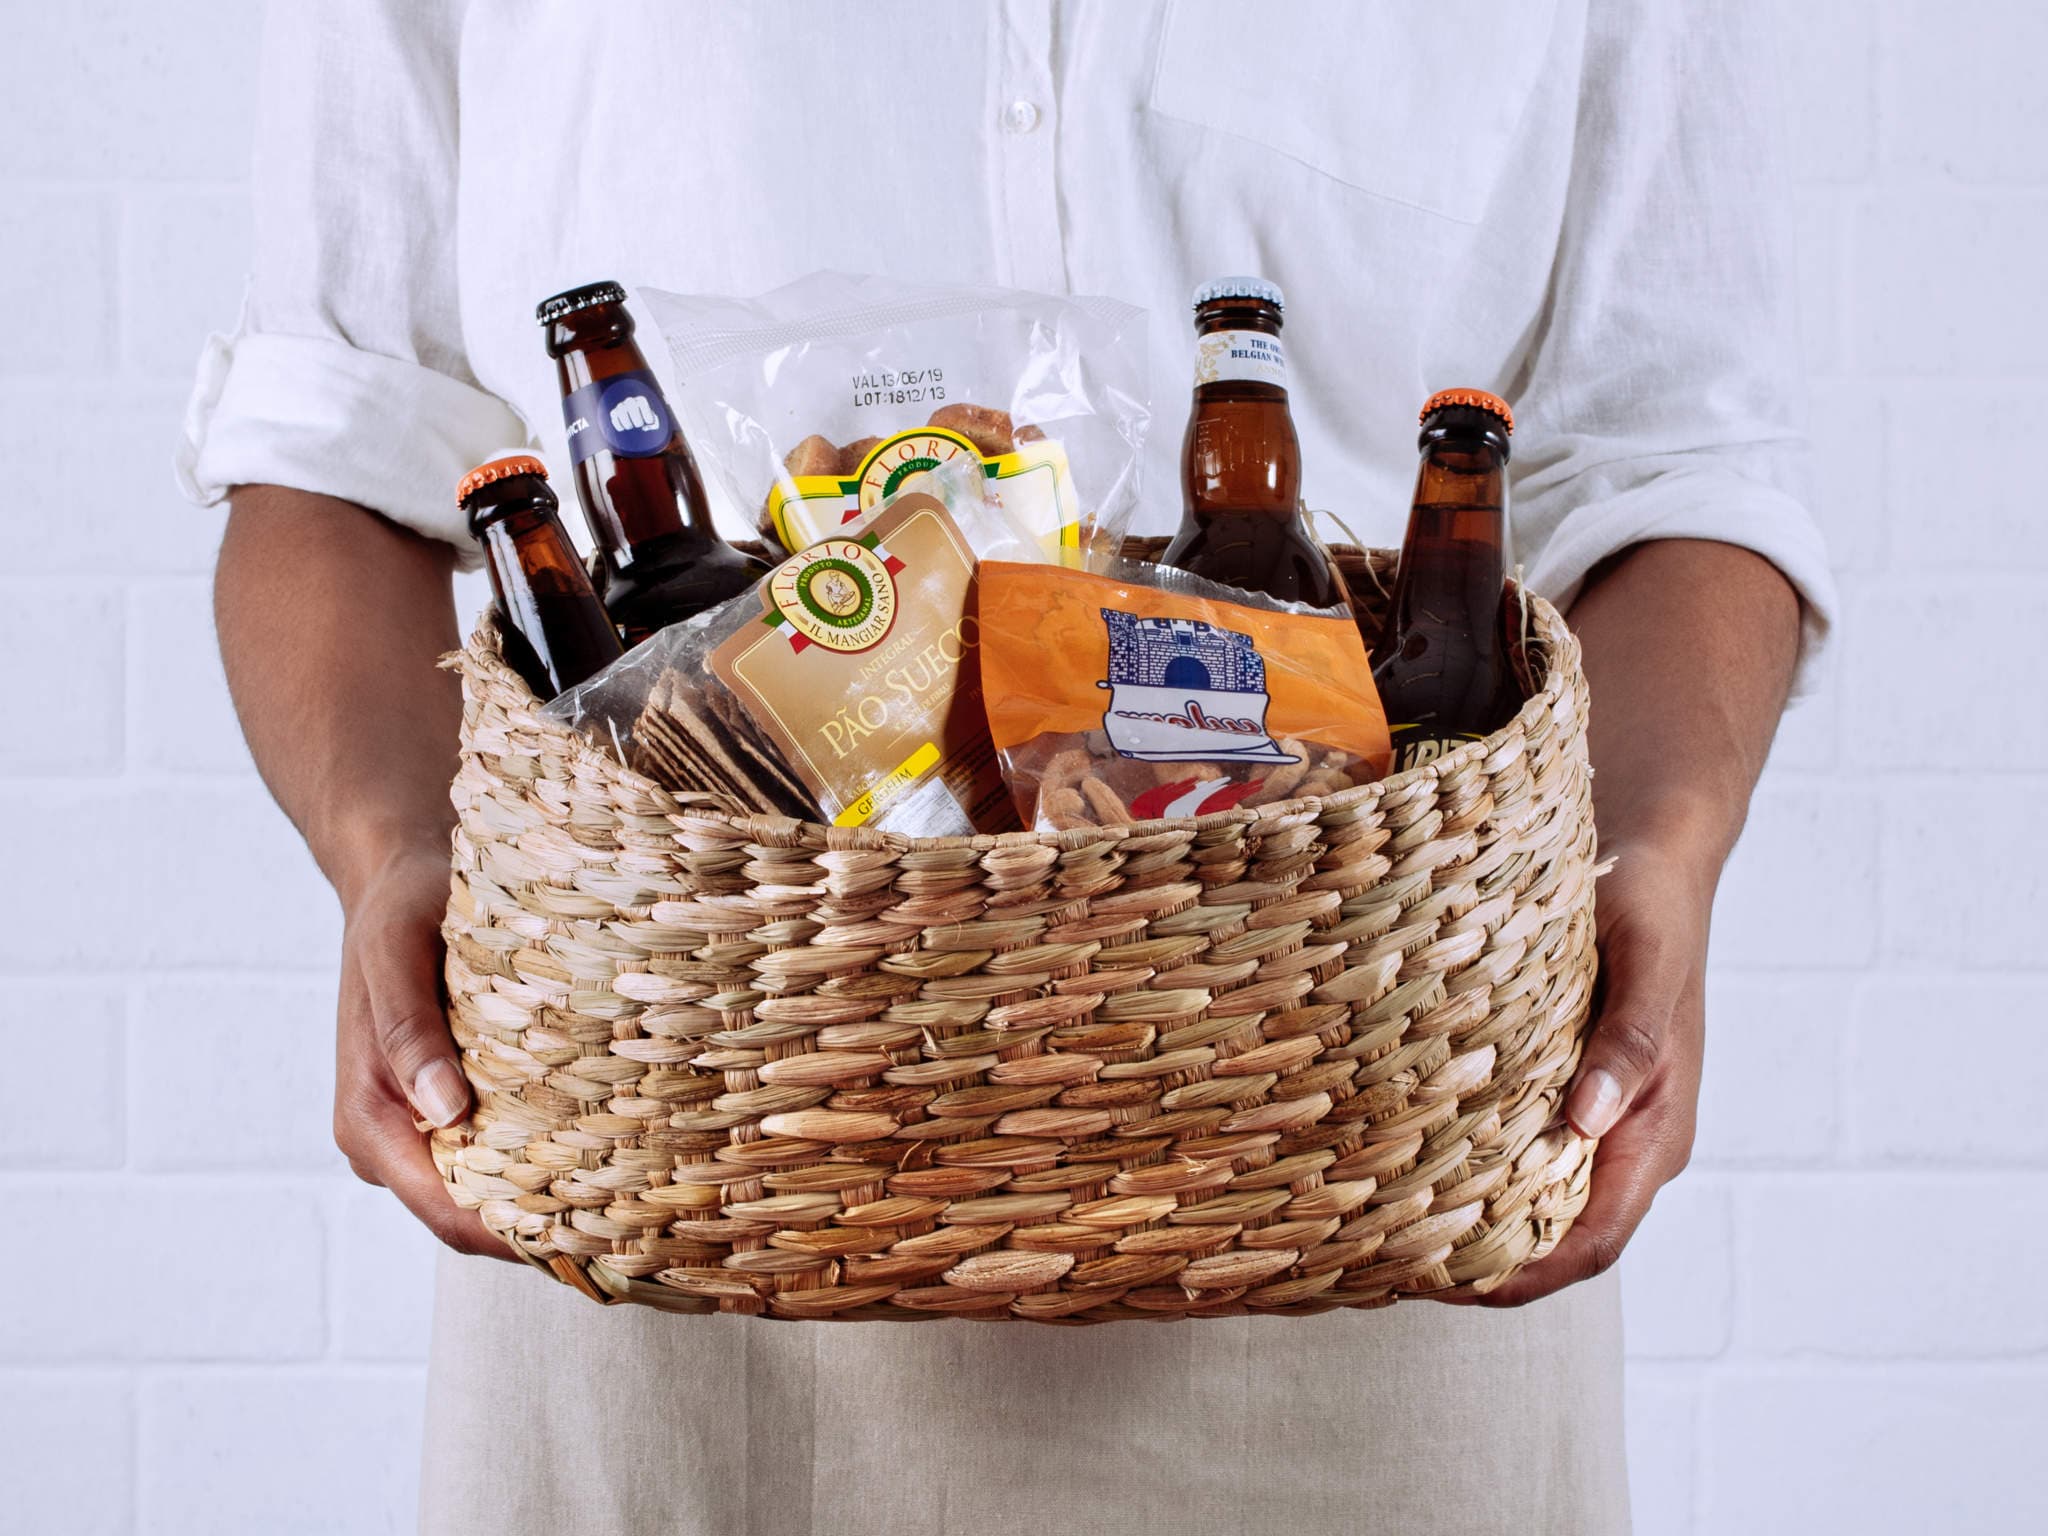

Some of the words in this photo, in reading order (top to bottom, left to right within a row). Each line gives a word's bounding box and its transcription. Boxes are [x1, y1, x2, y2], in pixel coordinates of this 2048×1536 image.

[1231, 349, 1272, 361] BELGIAN
[1250, 339, 1268, 350] THE
[865, 440, 959, 488] FLORI
[898, 461, 936, 477] PRODUT
[775, 543, 862, 609] FLORIO
[800, 560, 832, 587] PRODUTO
[809, 623, 823, 638] IL
[826, 615, 886, 647] MANGIAR
[872, 572, 890, 615] SANO
[837, 597, 872, 626] ARTESANAL
[860, 634, 916, 681] INTEGRAL
[818, 695, 888, 760] PÃO
[885, 615, 980, 707] SUECO
